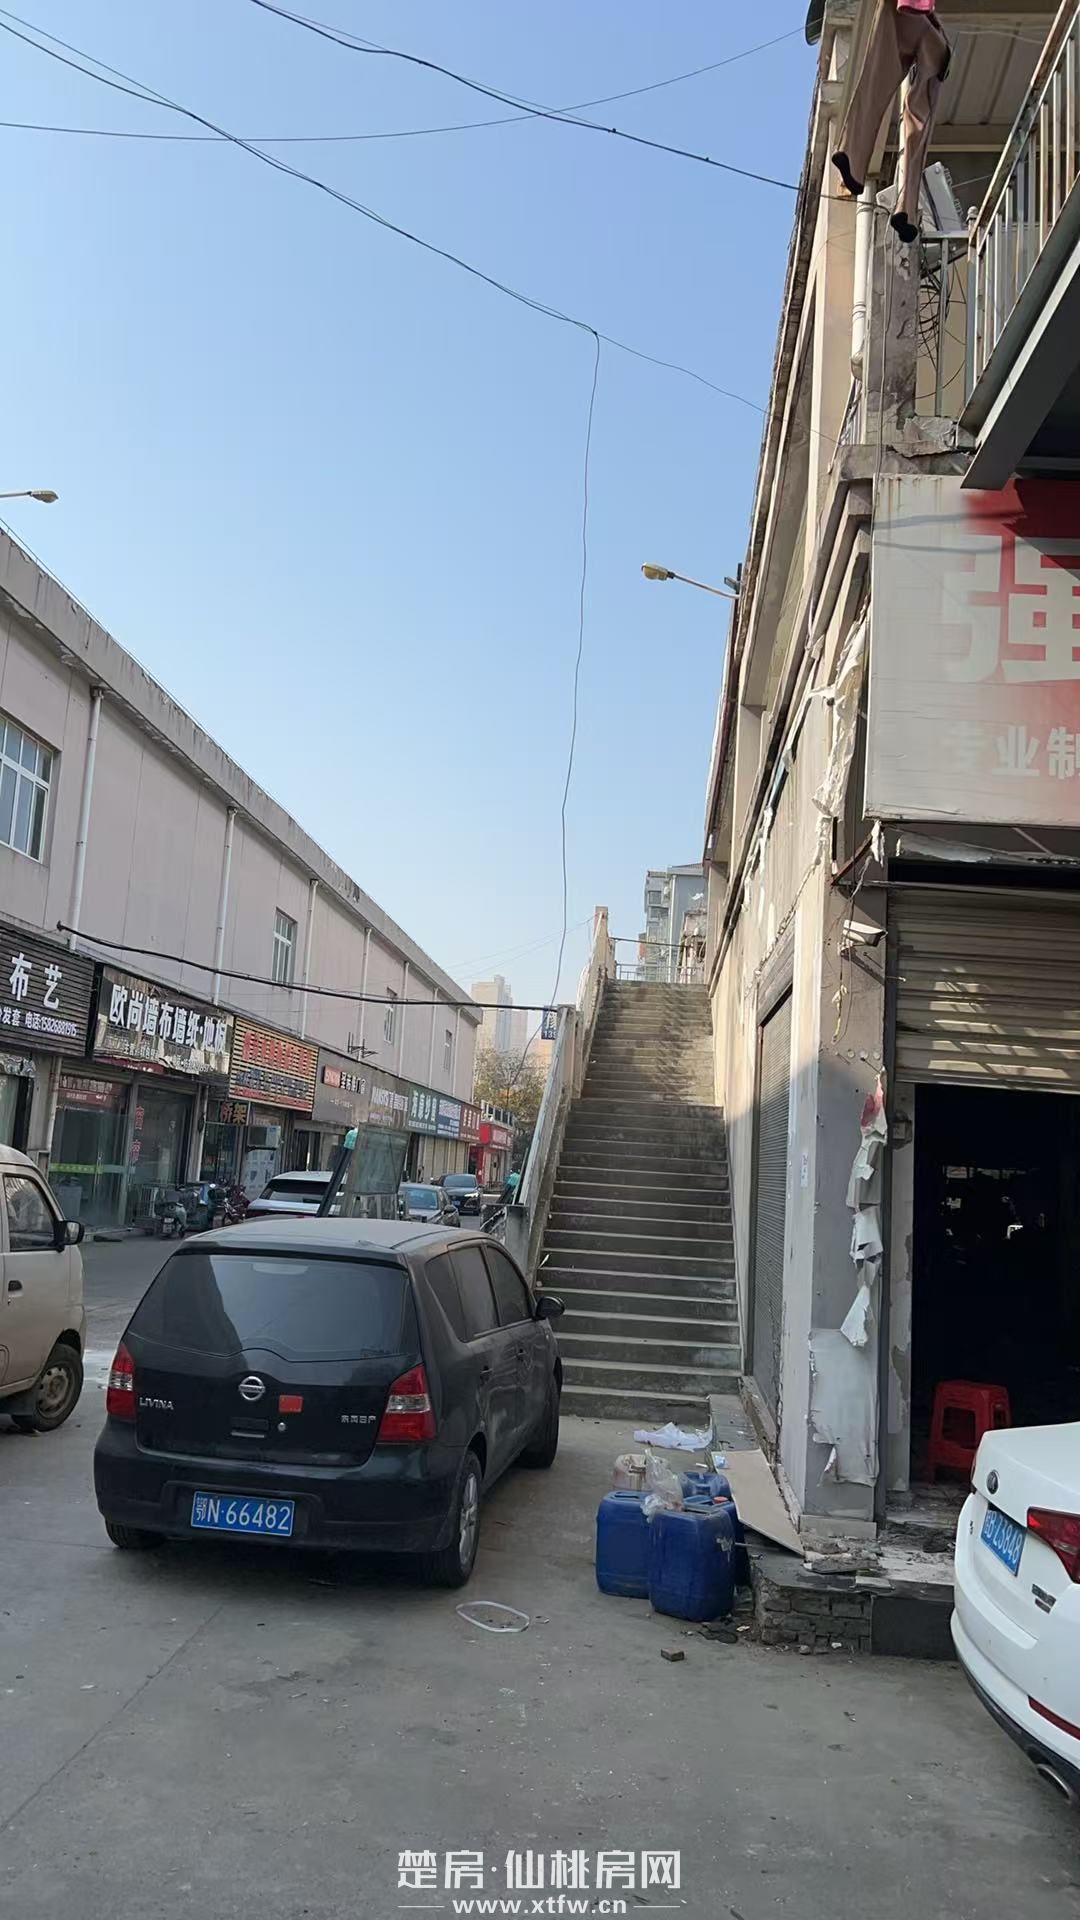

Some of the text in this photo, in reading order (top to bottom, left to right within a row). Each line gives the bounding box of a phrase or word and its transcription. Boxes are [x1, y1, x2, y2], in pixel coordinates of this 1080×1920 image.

[9, 951, 62, 1010] 布艺
[0, 1005, 21, 1027] 发套
[139, 1397, 174, 1410] LIVINA
